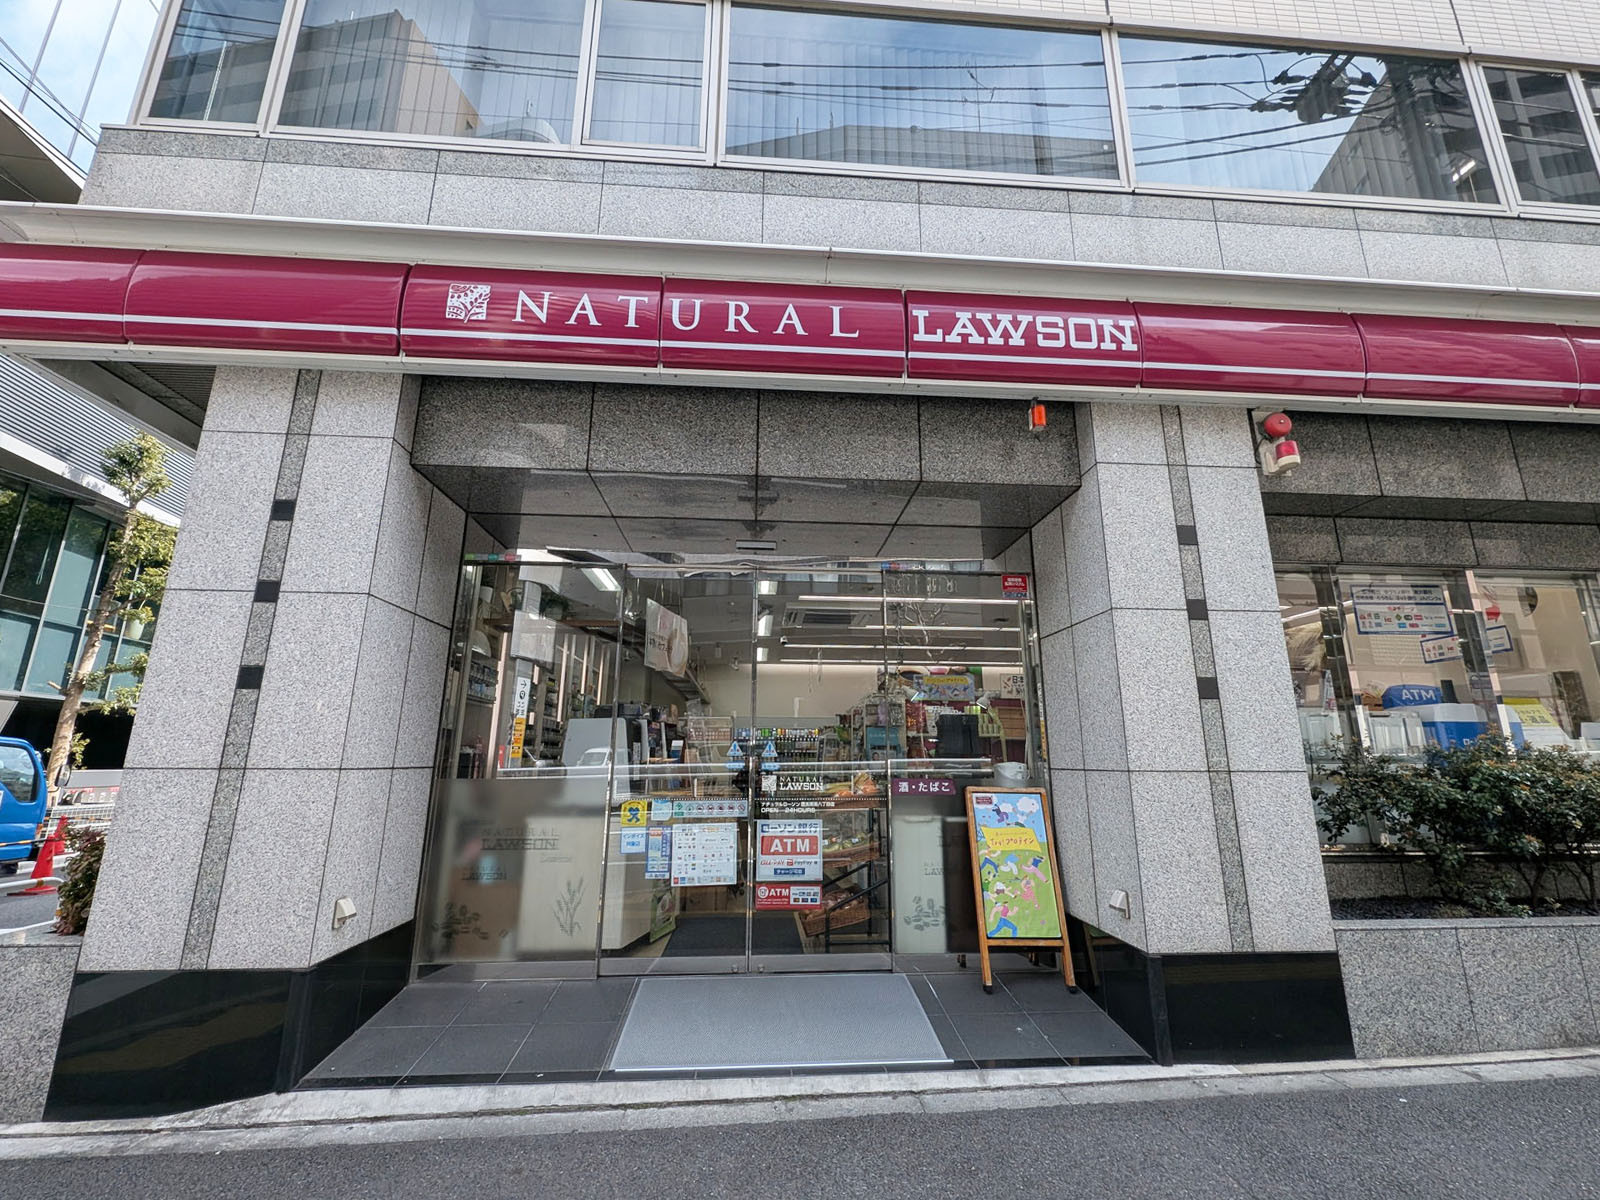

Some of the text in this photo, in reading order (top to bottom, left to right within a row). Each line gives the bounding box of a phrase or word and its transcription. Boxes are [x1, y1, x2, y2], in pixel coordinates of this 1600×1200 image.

[511, 289, 1138, 351] NATURAL LAWSON
[1401, 689, 1437, 700] ATM
[779, 782, 824, 791] LAWSON
[898, 781, 950, 793] 酒・たばこ
[480, 837, 560, 850] LAWSON
[769, 838, 810, 853] ATM
[768, 888, 790, 897] ATM
